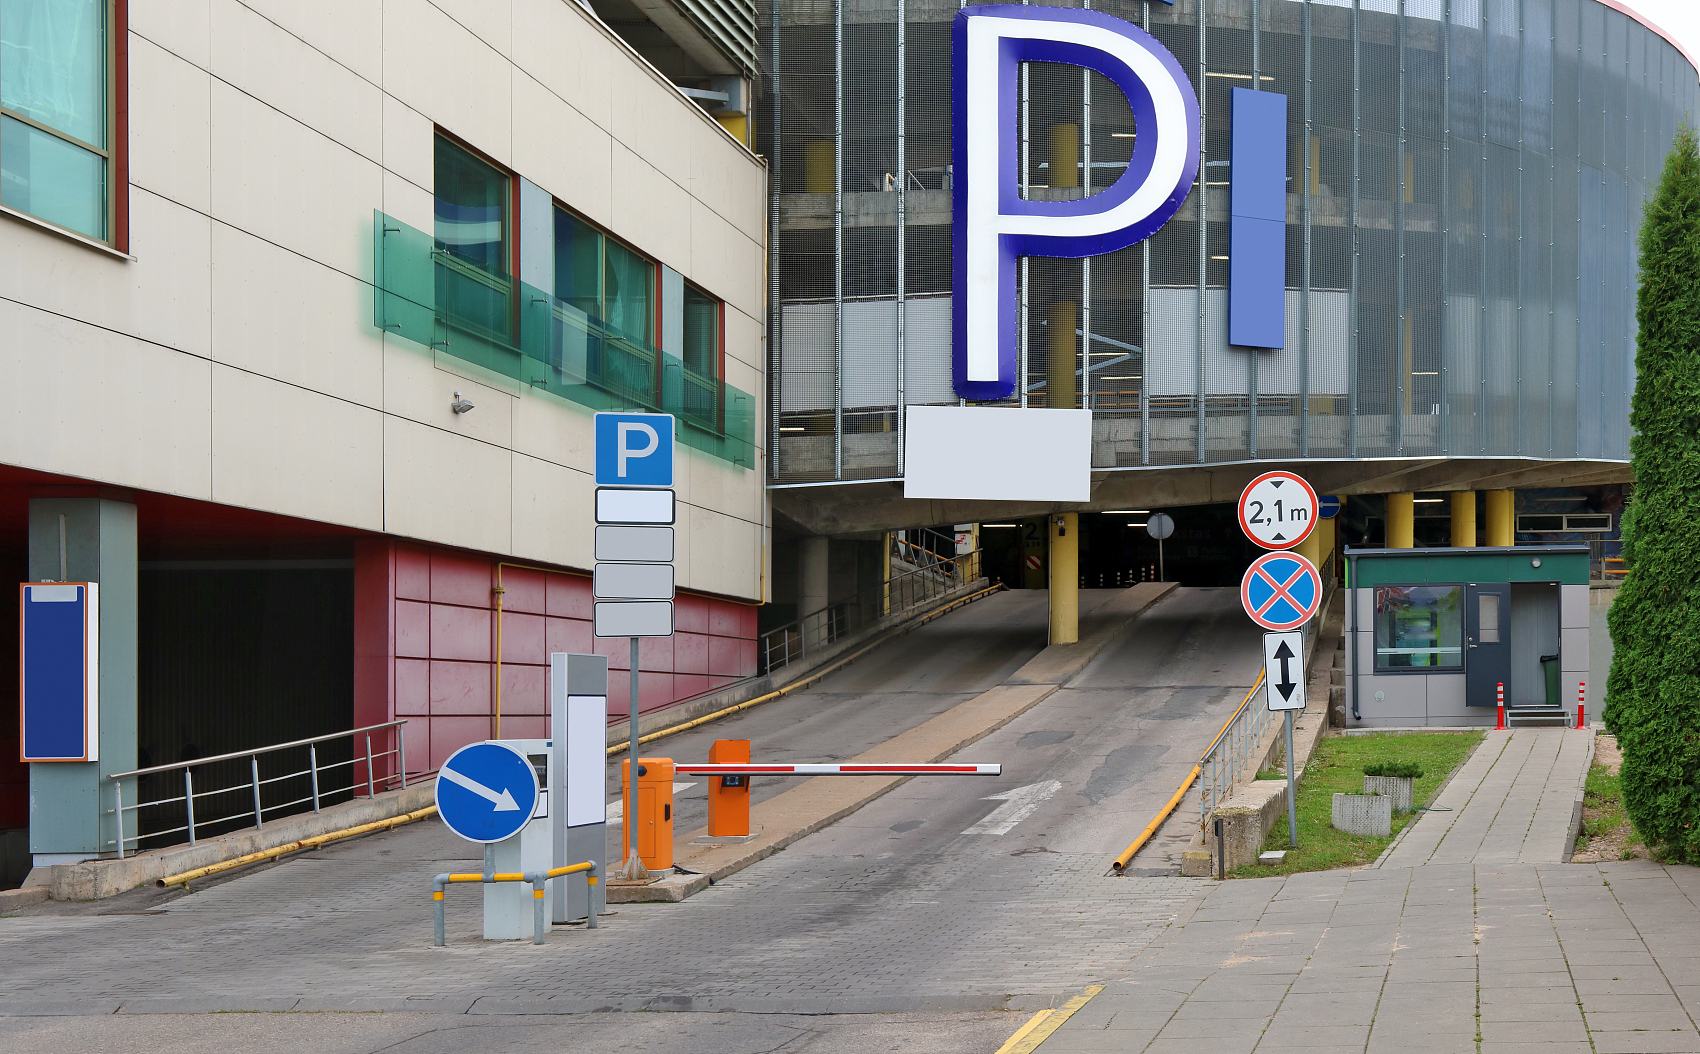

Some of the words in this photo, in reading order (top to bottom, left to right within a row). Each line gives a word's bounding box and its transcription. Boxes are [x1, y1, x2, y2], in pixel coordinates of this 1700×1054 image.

[960, 10, 1194, 390] P
[617, 421, 659, 478] P
[1023, 522, 1040, 541] 2
[1249, 499, 1283, 527] 2,1
[1290, 508, 1308, 521] m
